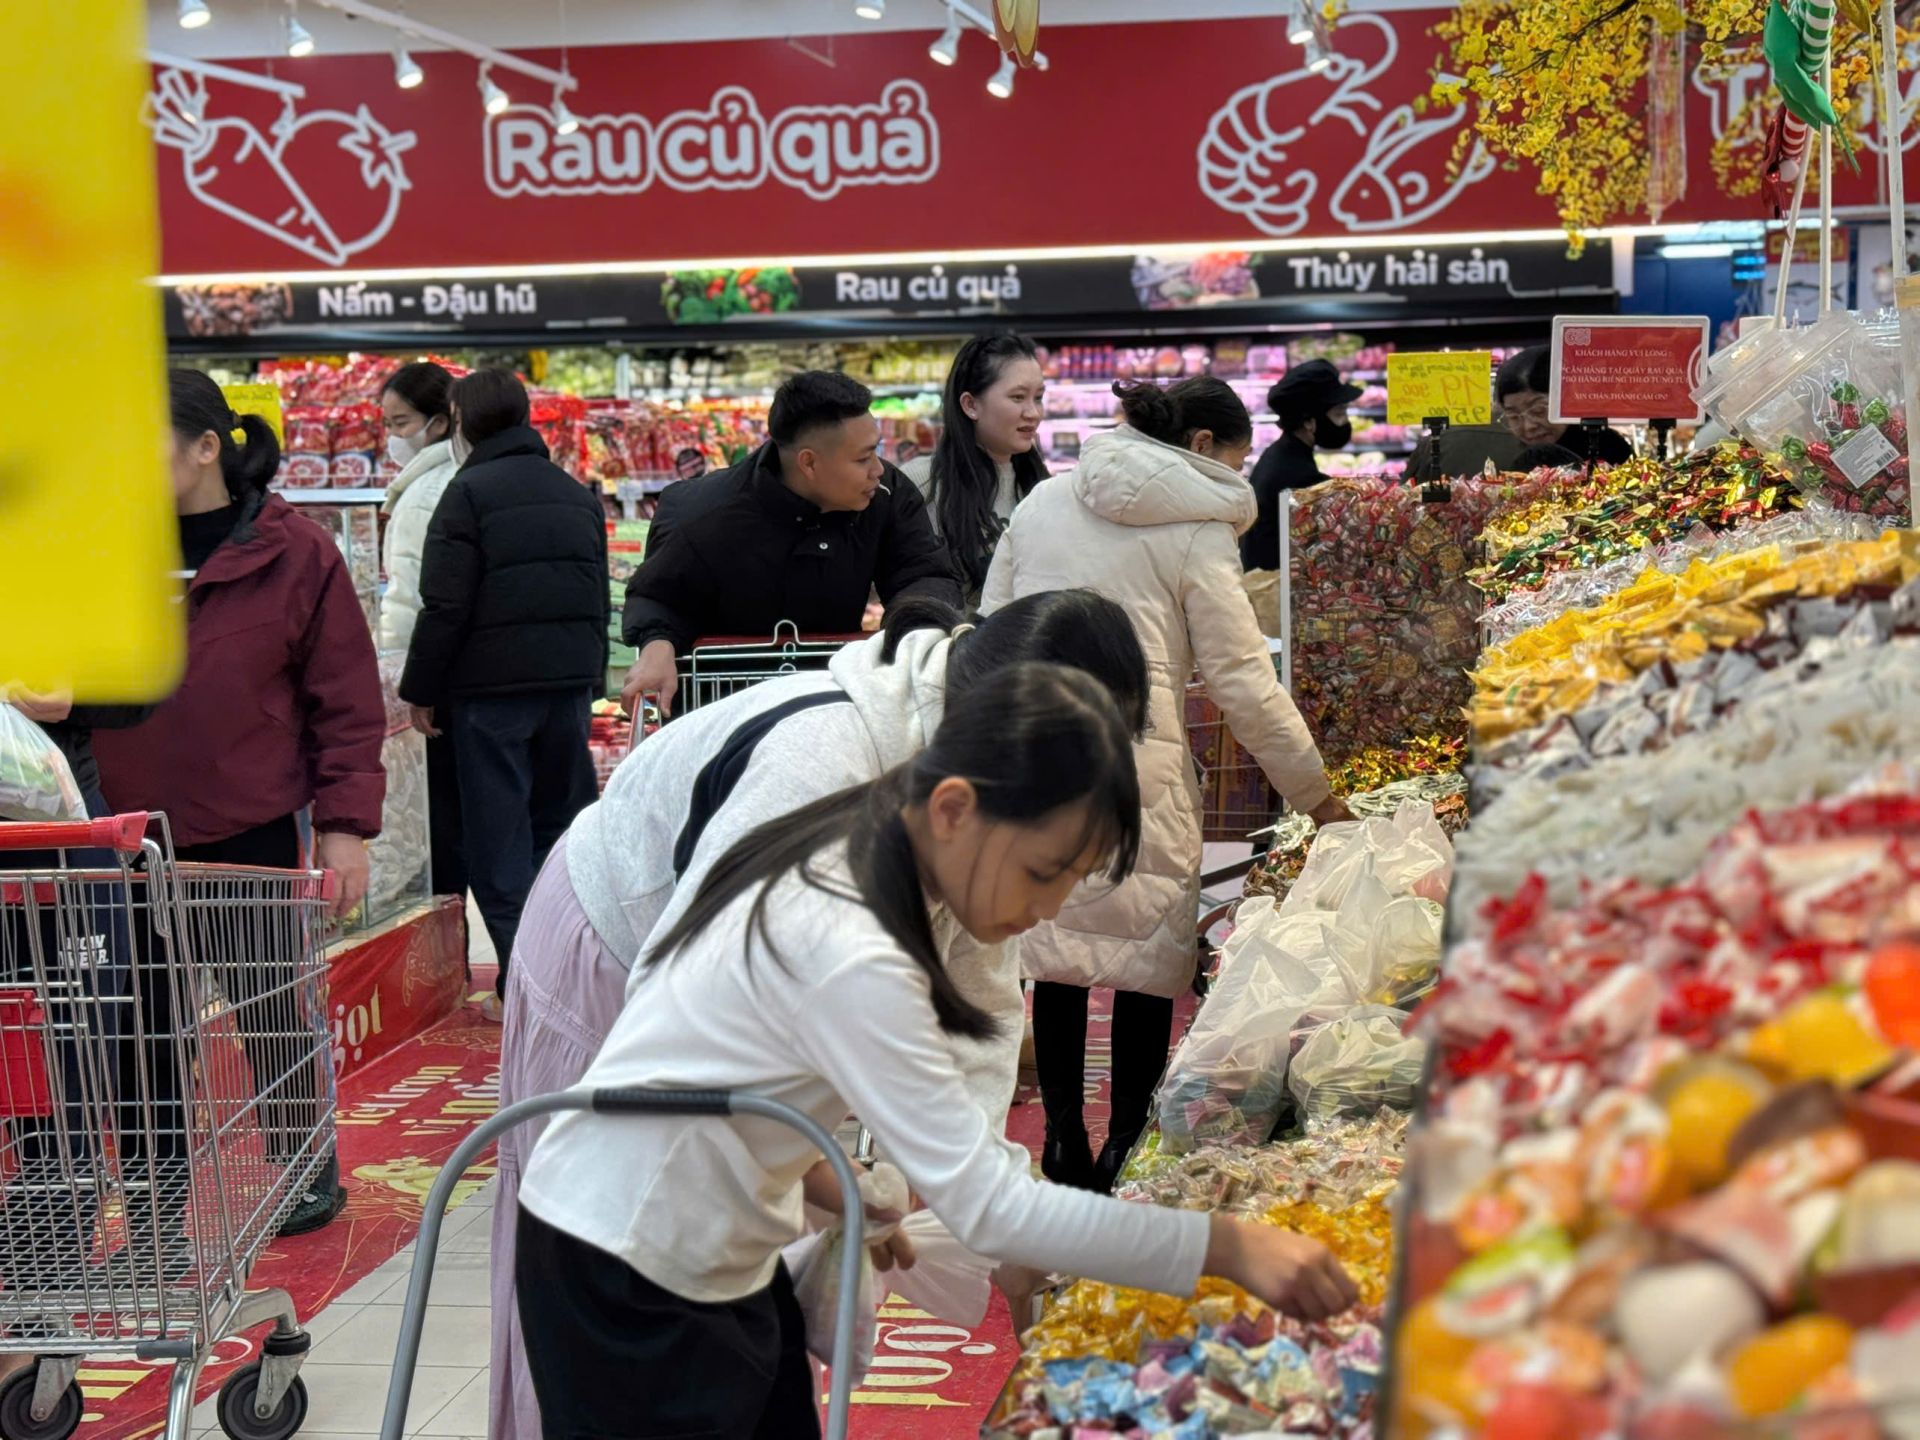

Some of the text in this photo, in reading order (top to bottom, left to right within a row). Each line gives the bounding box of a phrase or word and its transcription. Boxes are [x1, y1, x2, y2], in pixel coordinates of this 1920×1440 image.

[497, 94, 926, 185] Rau củ quả
[835, 264, 1022, 306] Rau củ quả
[1287, 247, 1509, 292] Thủy hải sản
[318, 280, 394, 316] Nấm
[421, 282, 488, 321] Đậu
[495, 282, 537, 315] hũ
